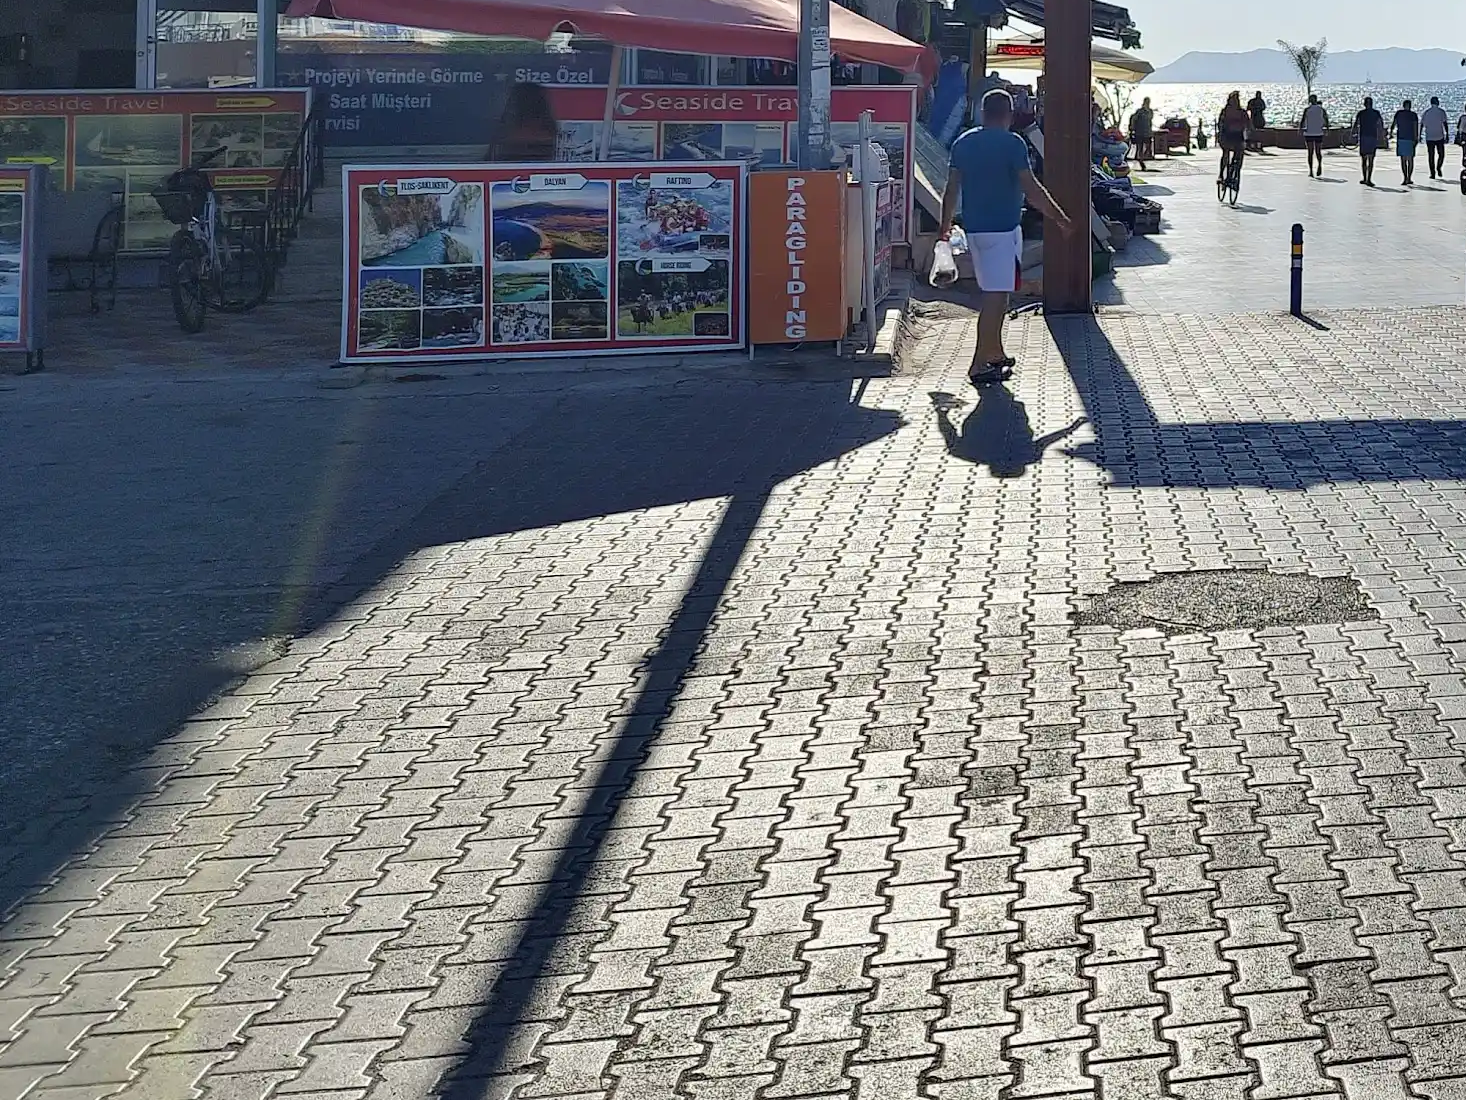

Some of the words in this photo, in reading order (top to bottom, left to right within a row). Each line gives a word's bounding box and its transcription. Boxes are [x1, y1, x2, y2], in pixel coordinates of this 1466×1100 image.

[304, 67, 361, 88] Projeyi
[366, 67, 426, 85] Yerinde
[430, 68, 484, 86] Görme
[514, 68, 551, 84] Size
[556, 65, 594, 84] Özel
[6, 96, 94, 112] Seaside
[102, 95, 166, 111] Travel
[329, 93, 367, 110] Saat
[371, 93, 432, 112] Müşteri
[640, 91, 744, 112] Seaside
[544, 177, 567, 187] DALYAN
[785, 177, 807, 339] PARAGLIDING
